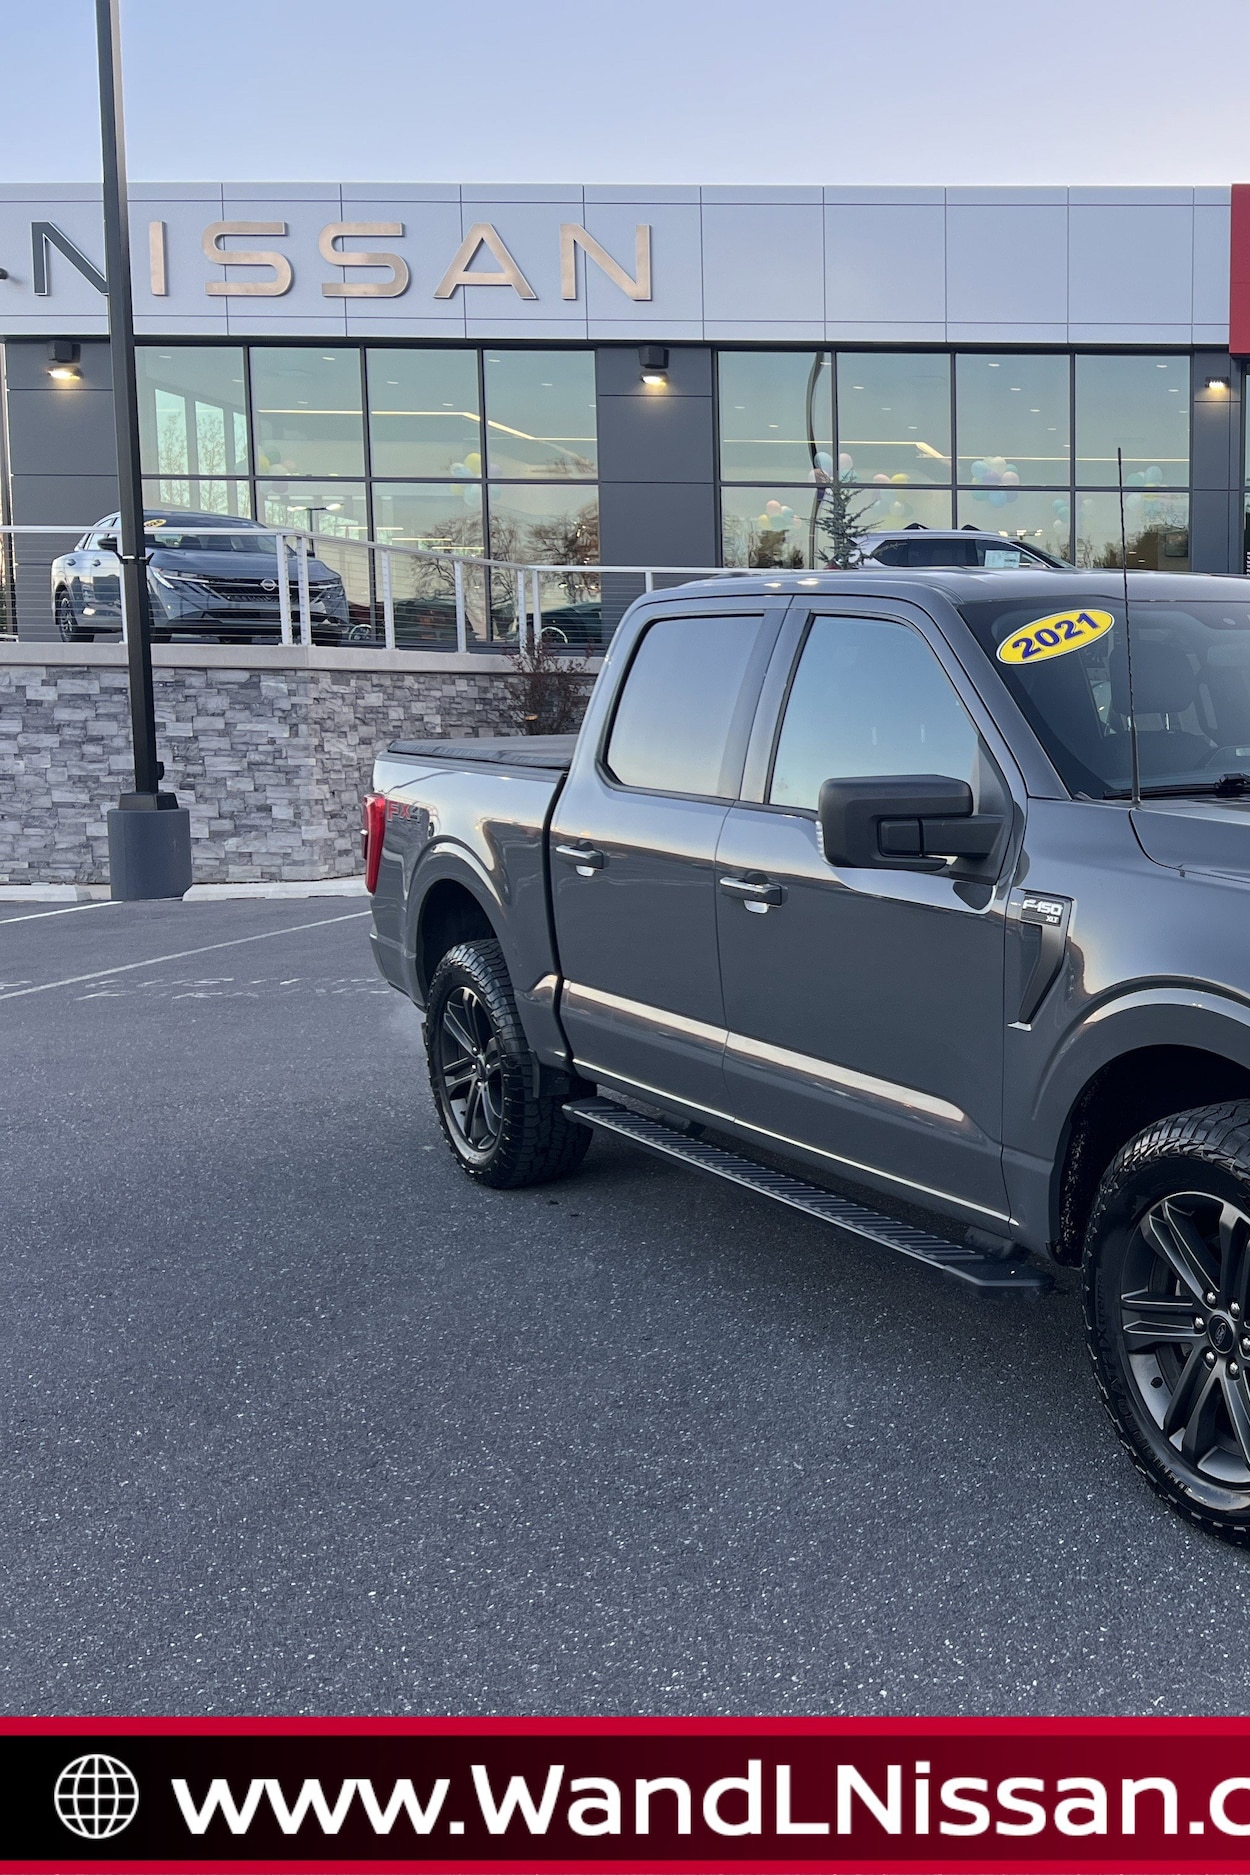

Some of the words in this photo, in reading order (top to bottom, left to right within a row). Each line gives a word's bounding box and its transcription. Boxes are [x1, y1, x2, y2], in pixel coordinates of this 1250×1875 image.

[31, 220, 653, 301] NISSAN
[1011, 611, 1101, 660] 2021
[386, 799, 422, 825] FX4
[1022, 898, 1064, 917] F-150
[1045, 915, 1060, 924] XLT
